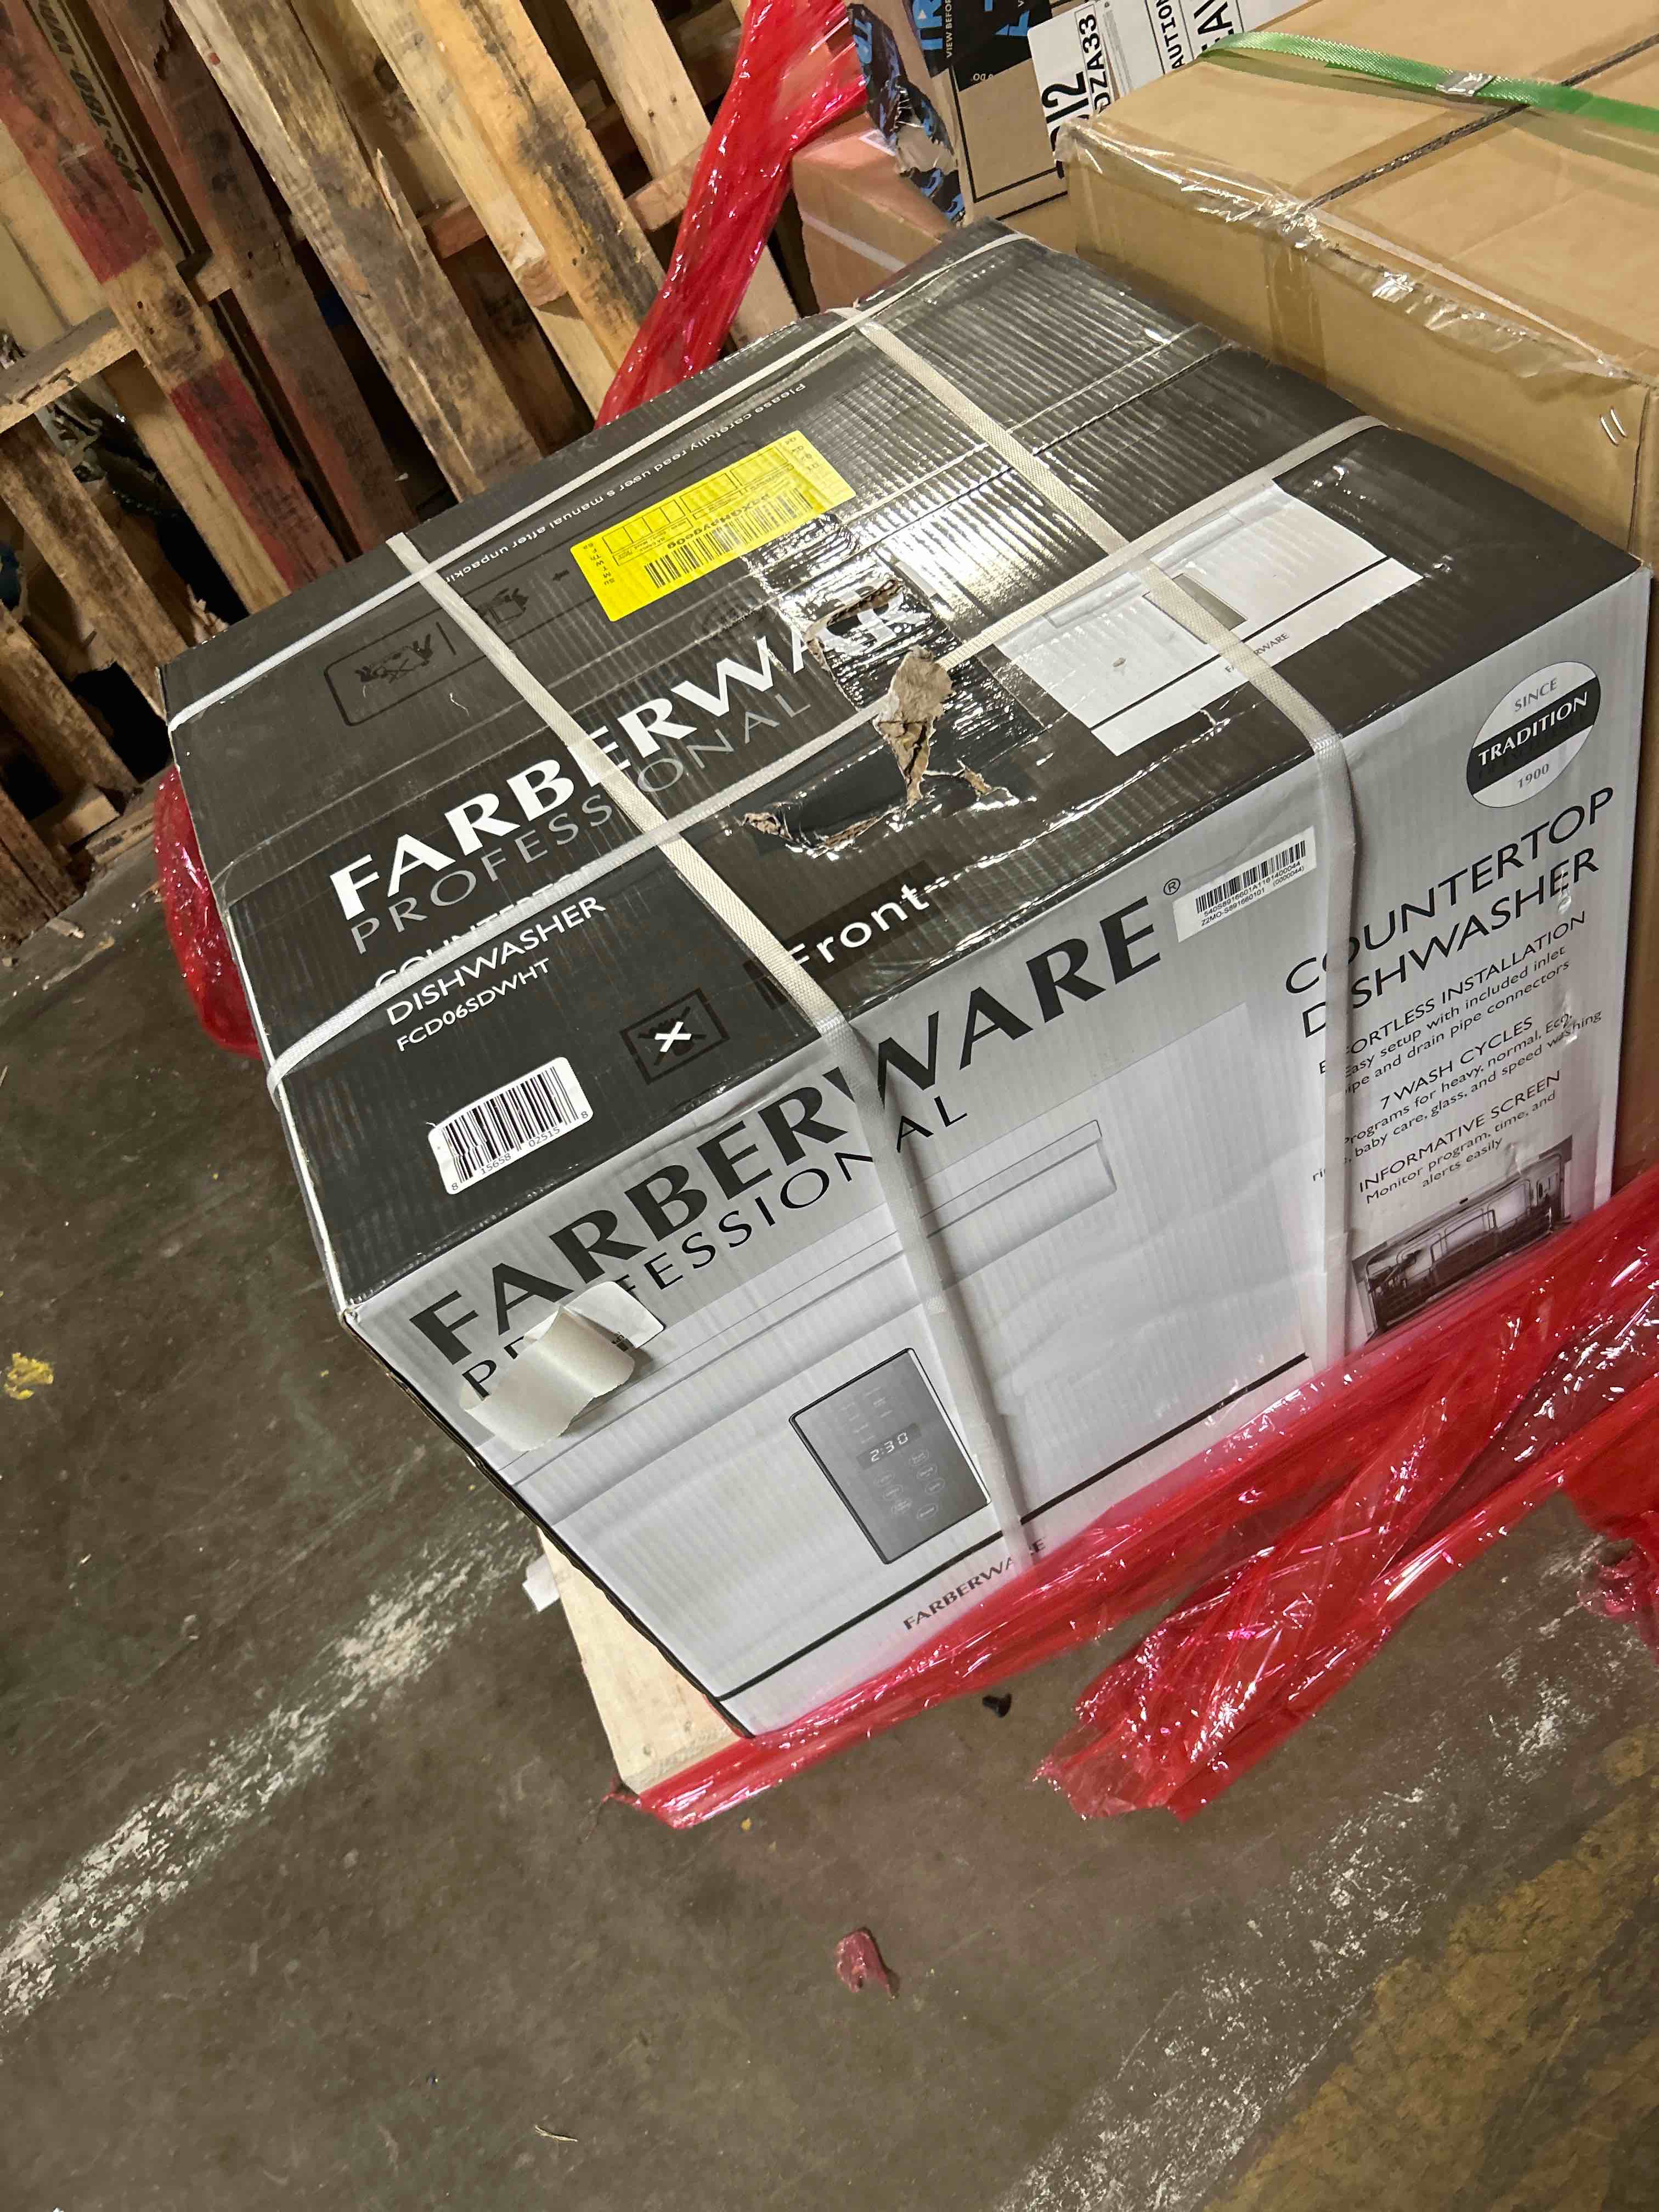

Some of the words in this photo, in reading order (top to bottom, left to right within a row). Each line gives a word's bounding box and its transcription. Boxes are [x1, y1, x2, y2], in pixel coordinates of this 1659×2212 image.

[1156, 0, 1184, 69] AUTIO
[689, 413, 752, 450] carefully
[755, 383, 805, 413] Please
[654, 451, 686, 470] read
[511, 527, 545, 548] after
[549, 495, 603, 528] manual
[444, 545, 507, 584] unpacki
[1478, 691, 1588, 766] TRADITION
[1514, 677, 1558, 712] SINCE
[1517, 763, 1549, 788] 1900
[349, 693, 811, 955] PROFESSONAL
[386, 896, 607, 1026] DISHWASHER
[1302, 848, 1599, 1038] DSHWASHER
[396, 958, 550, 1052] FCD06SDWHT
[1319, 998, 1435, 1075] EORTLESS
[1441, 911, 1585, 1005] INSTALLATION
[1345, 1075, 1370, 1093] ipe
[1375, 1054, 1401, 1077] and
[1408, 1034, 1444, 1059] drain
[1451, 1013, 1482, 1039] pipe
[1487, 960, 1570, 1014] connectors
[1380, 1030, 1421, 1057] setup
[1427, 1007, 1459, 1030] with
[1465, 967, 1528, 1010] included
[1534, 945, 1566, 972] inlet
[1355, 1133, 1387, 1157] baby
[1471, 1070, 1497, 1092] and
[1502, 1045, 1542, 1075] speed
[1380, 1095, 1391, 1110] 7
[1393, 1060, 1453, 1101] WASH
[1460, 1016, 1533, 1064] CYCLES
[1414, 1090, 1436, 1108] for
[451, 1182, 459, 1191] 8
[481, 1153, 512, 1175] 15658
[528, 1126, 561, 1148] 02515
[580, 1111, 589, 1119] 8
[1359, 1114, 1485, 1193] INFORMATIVE
[1491, 1070, 1560, 1119] SCREEN
[1366, 1171, 1425, 1204] Monitor
[1532, 1090, 1556, 1111] and
[1422, 1160, 1462, 1188] alerts
[1466, 1136, 1503, 1164] easily
[461, 1095, 968, 1401] PESSIONAL
[868, 1431, 909, 1463] 2:30
[903, 1538, 1047, 1630] FARBERWAE
